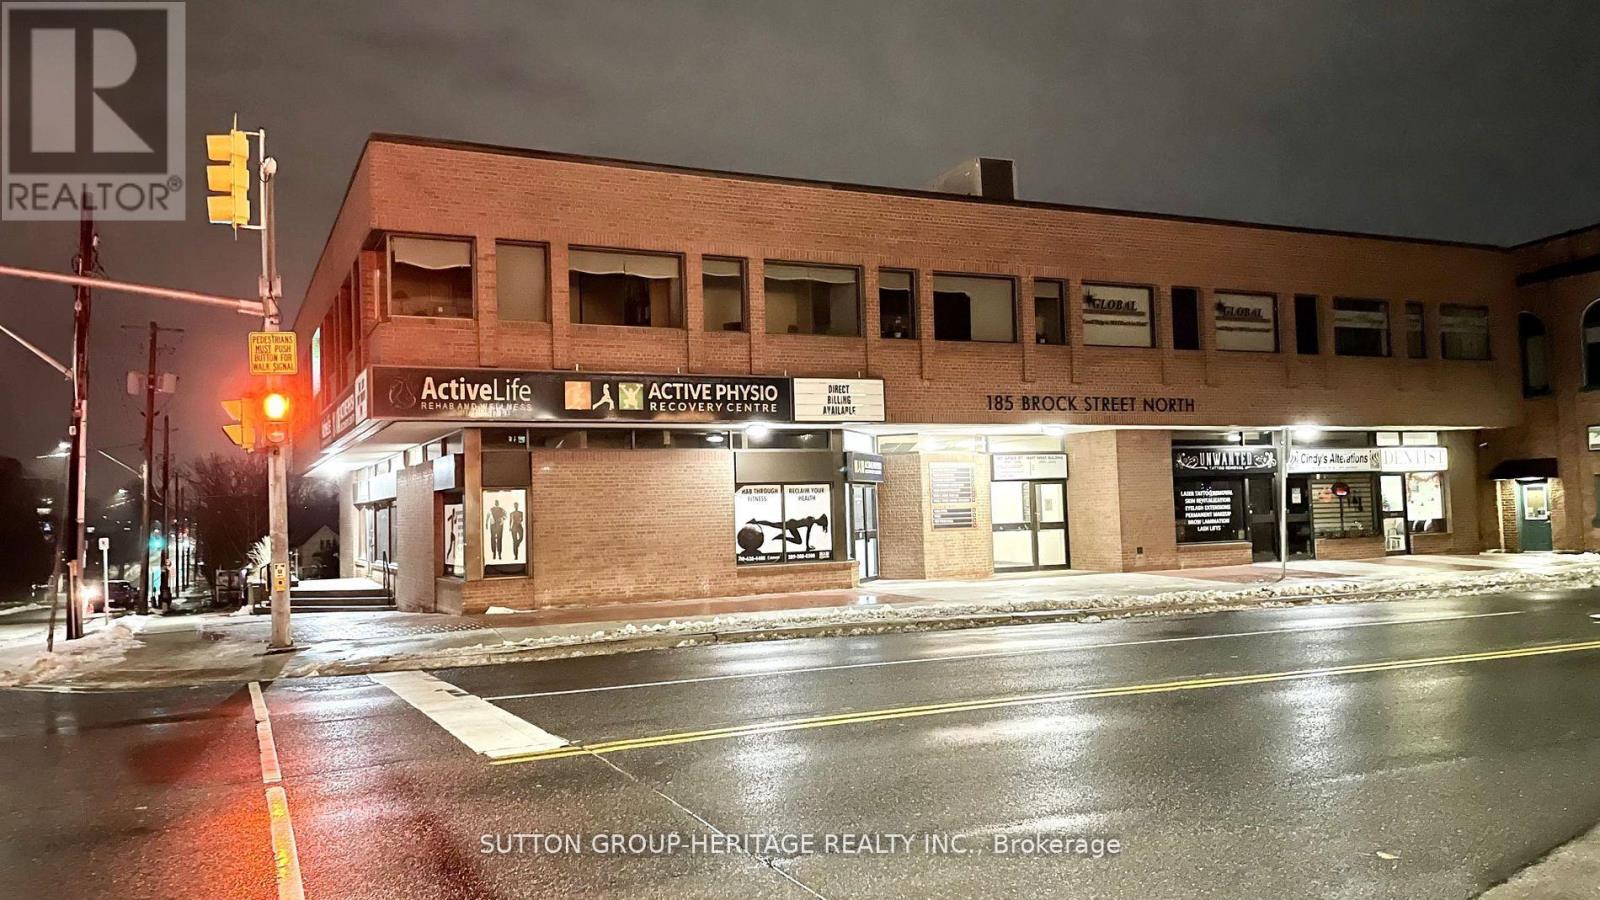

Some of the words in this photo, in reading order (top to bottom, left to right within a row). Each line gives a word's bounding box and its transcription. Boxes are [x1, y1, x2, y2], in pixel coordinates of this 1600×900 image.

[1092, 298, 1138, 312] GLOBAL
[1223, 305, 1264, 318] GLOBAL
[252, 335, 293, 344] PEDESTRIANS
[256, 345, 271, 353] MUST
[274, 345, 292, 353] PUSH
[255, 353, 278, 361] BUTTON
[280, 353, 292, 361] FOR
[253, 363, 270, 371] WALK
[272, 362, 294, 371] SIGNAL
[421, 376, 532, 402] ActiveLife
[648, 382, 711, 400] ACTIVE
[716, 384, 778, 402] PHYSIO
[828, 384, 850, 394] DIRECT
[827, 395, 852, 405] BILLING
[987, 395, 1014, 411] 185
[1021, 395, 1079, 411] BROCK
[1084, 397, 1137, 412] STREET
[1143, 397, 1195, 412] NORTH
[421, 401, 455, 410] REHAB
[457, 402, 478, 411] AND
[481, 402, 533, 412] WELLNESS
[650, 402, 723, 412] RECOVERY
[726, 403, 778, 413] CENTRE
[1199, 452, 1253, 466] UNWANTED
[1300, 452, 1329, 466] Cindy's
[1329, 451, 1369, 465] Alterations
[1383, 449, 1445, 465] DENTIST
